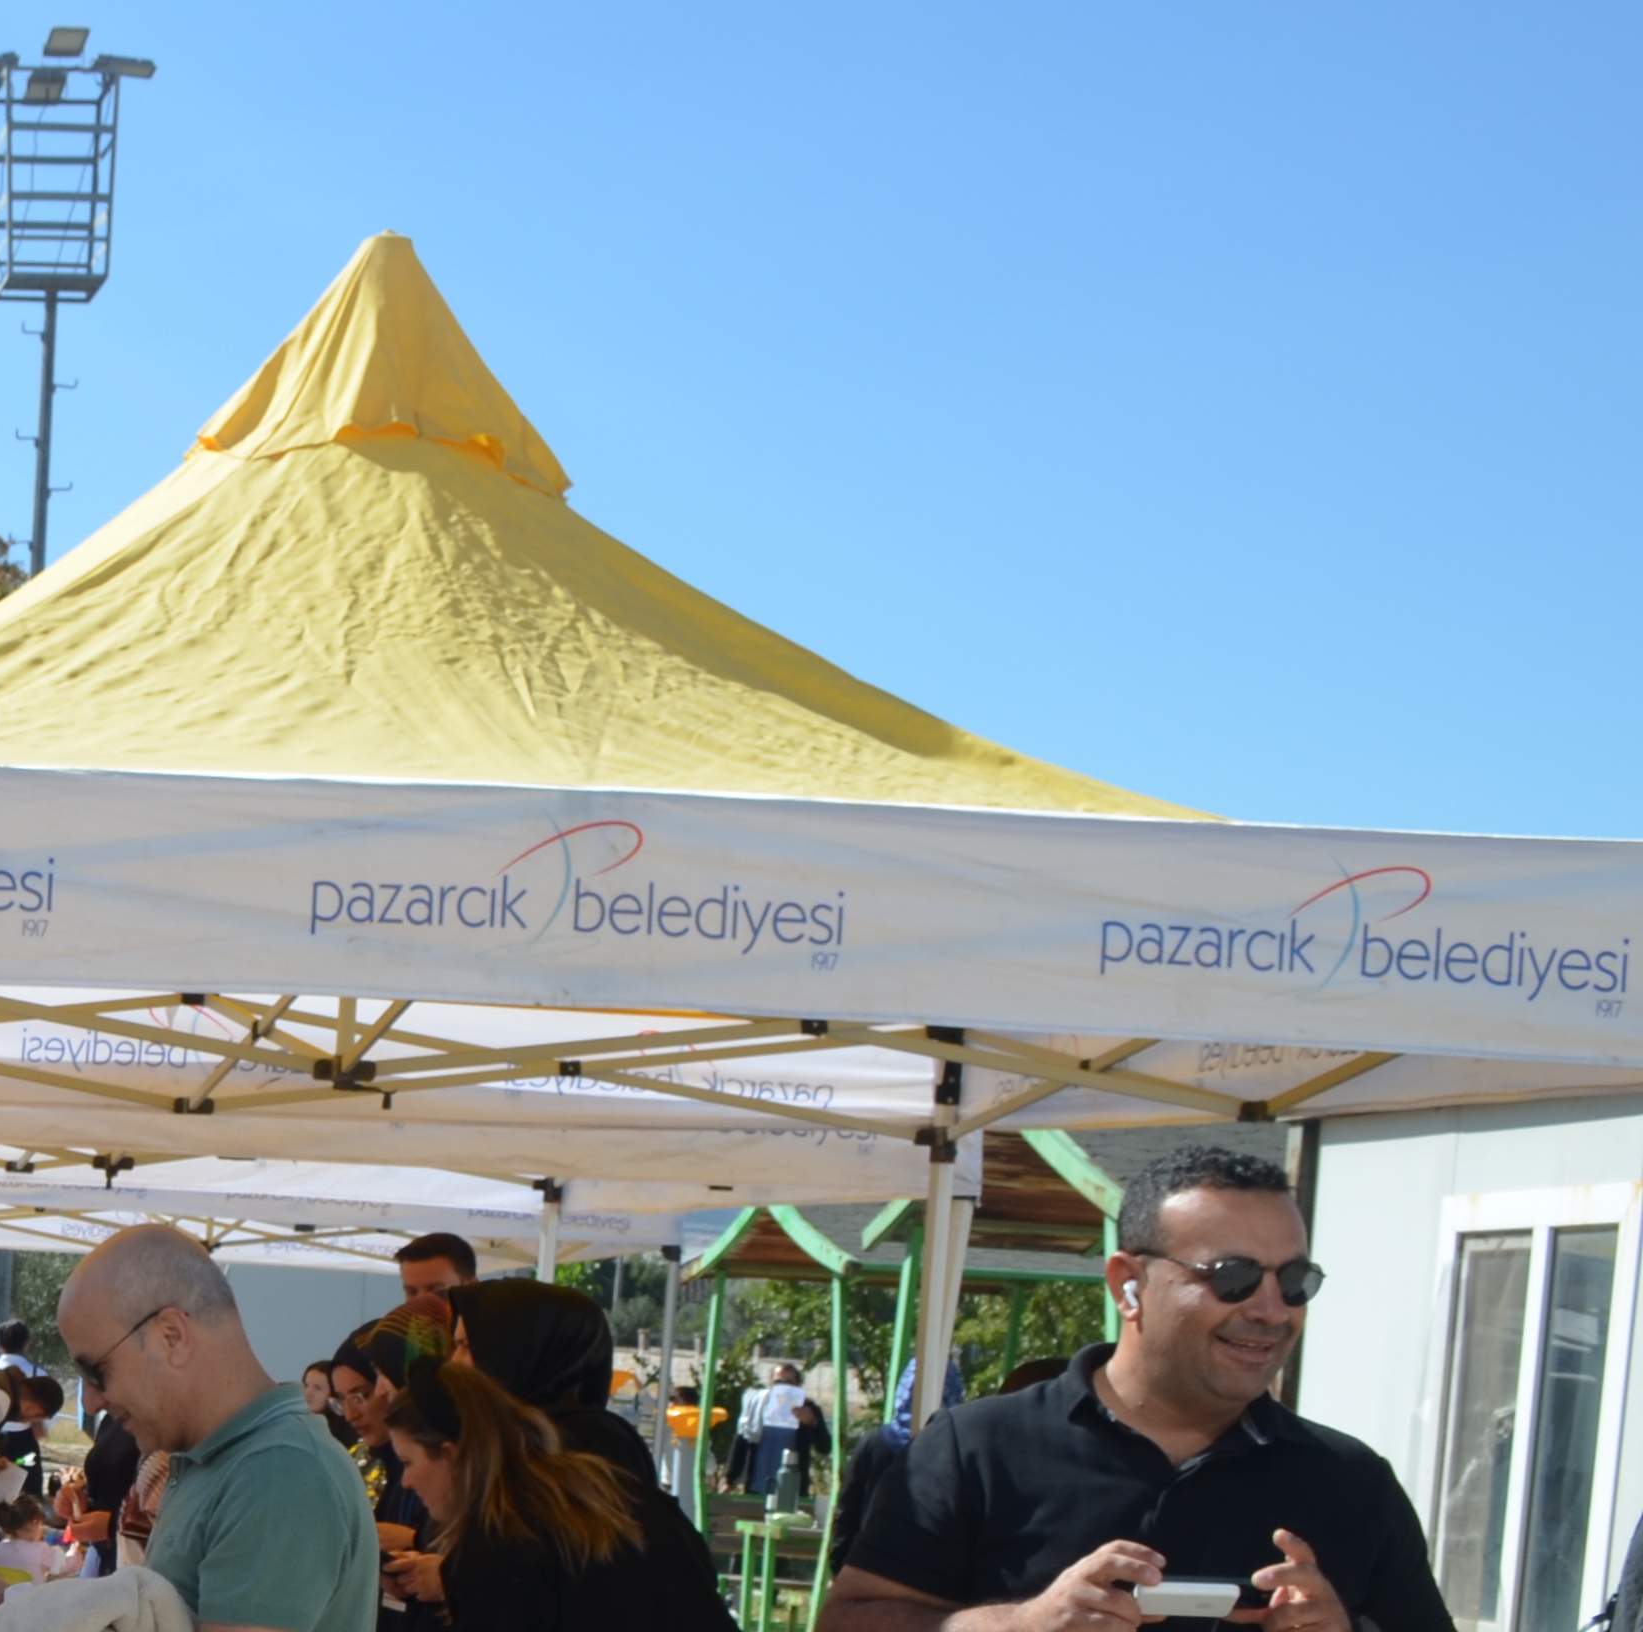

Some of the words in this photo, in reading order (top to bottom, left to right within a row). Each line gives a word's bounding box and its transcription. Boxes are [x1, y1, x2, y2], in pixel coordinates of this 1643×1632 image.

[310, 876, 528, 935] pazarcık
[573, 879, 846, 955] belediyesi
[1100, 918, 1315, 975] pazarcık
[1360, 924, 1630, 1002] belediyesi
